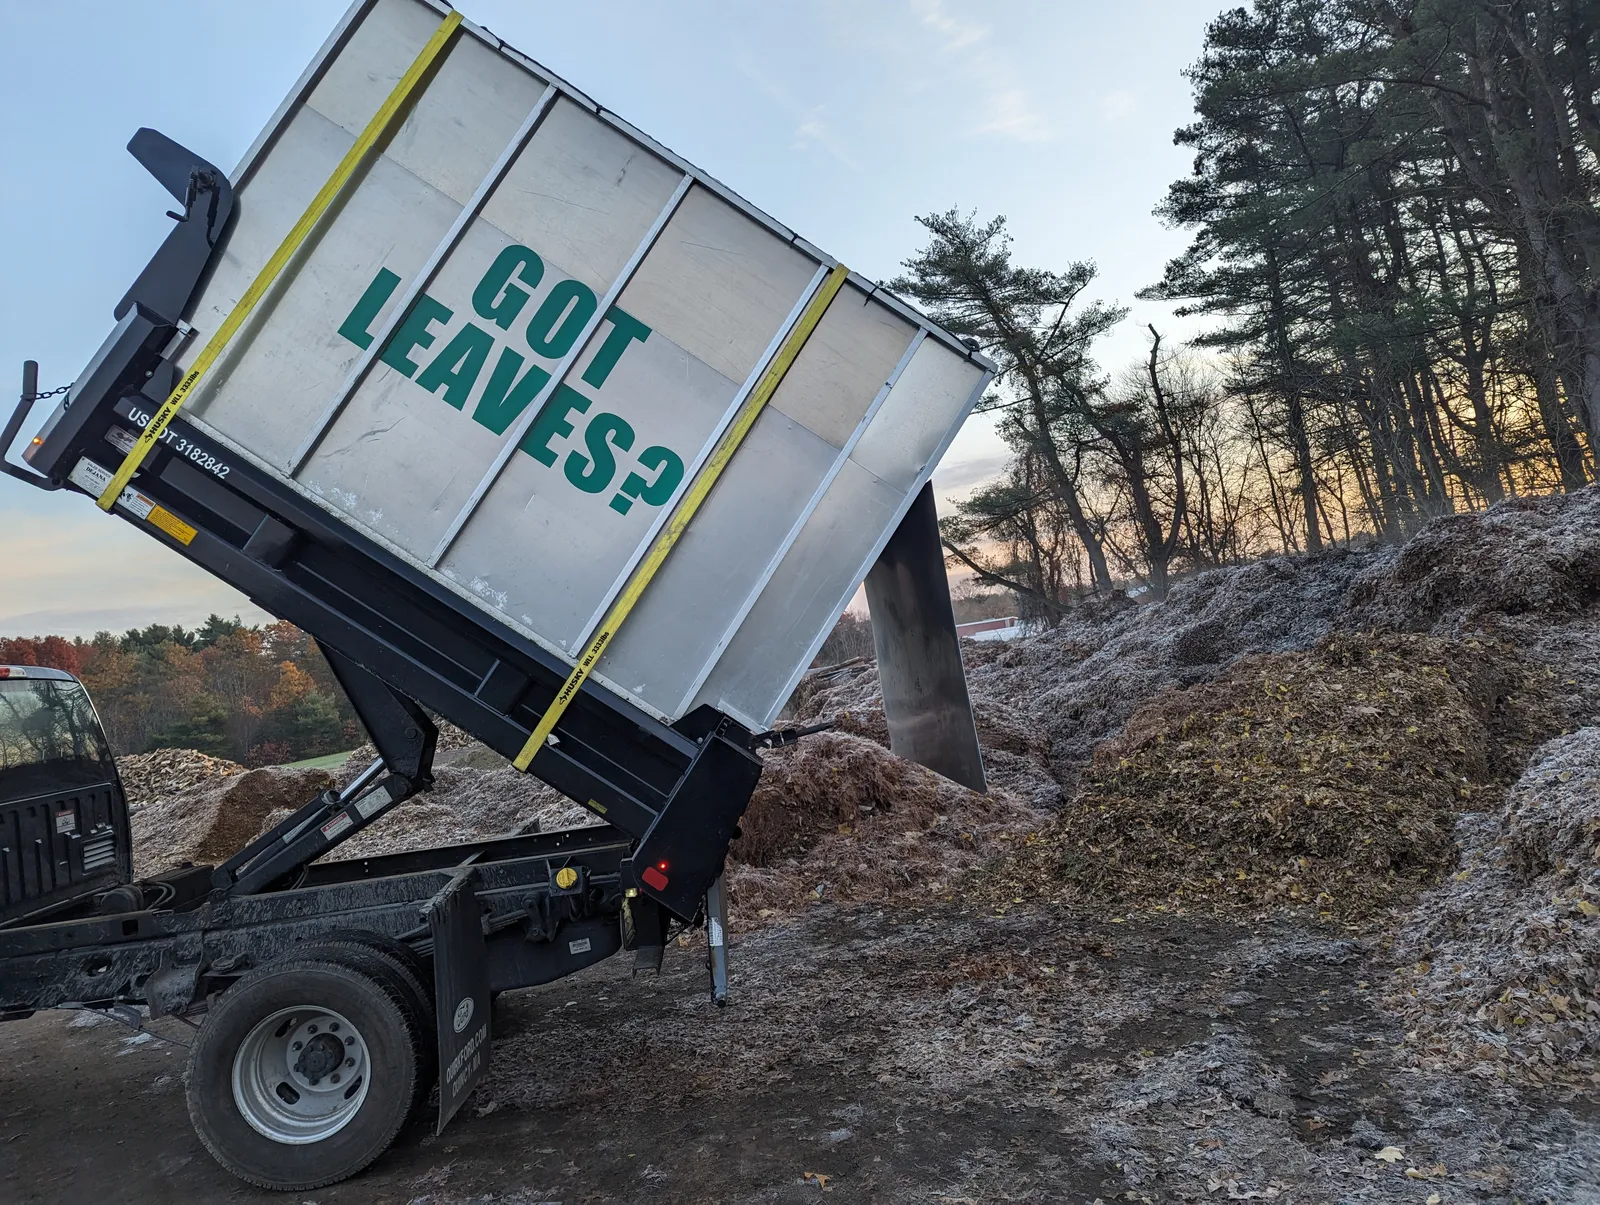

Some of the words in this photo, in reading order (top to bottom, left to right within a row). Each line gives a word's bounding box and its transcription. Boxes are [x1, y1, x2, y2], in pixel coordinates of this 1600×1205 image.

[472, 245, 652, 390] GOT
[150, 406, 171, 434] HUSKY
[170, 393, 183, 406] WLL
[180, 370, 200, 393] 3333lbs
[337, 267, 684, 516] LEAVES?
[86, 466, 106, 481] DEJANA
[175, 439, 230, 479] 3182842
[564, 668, 585, 697] HUSKY
[583, 654, 595, 667] WLL
